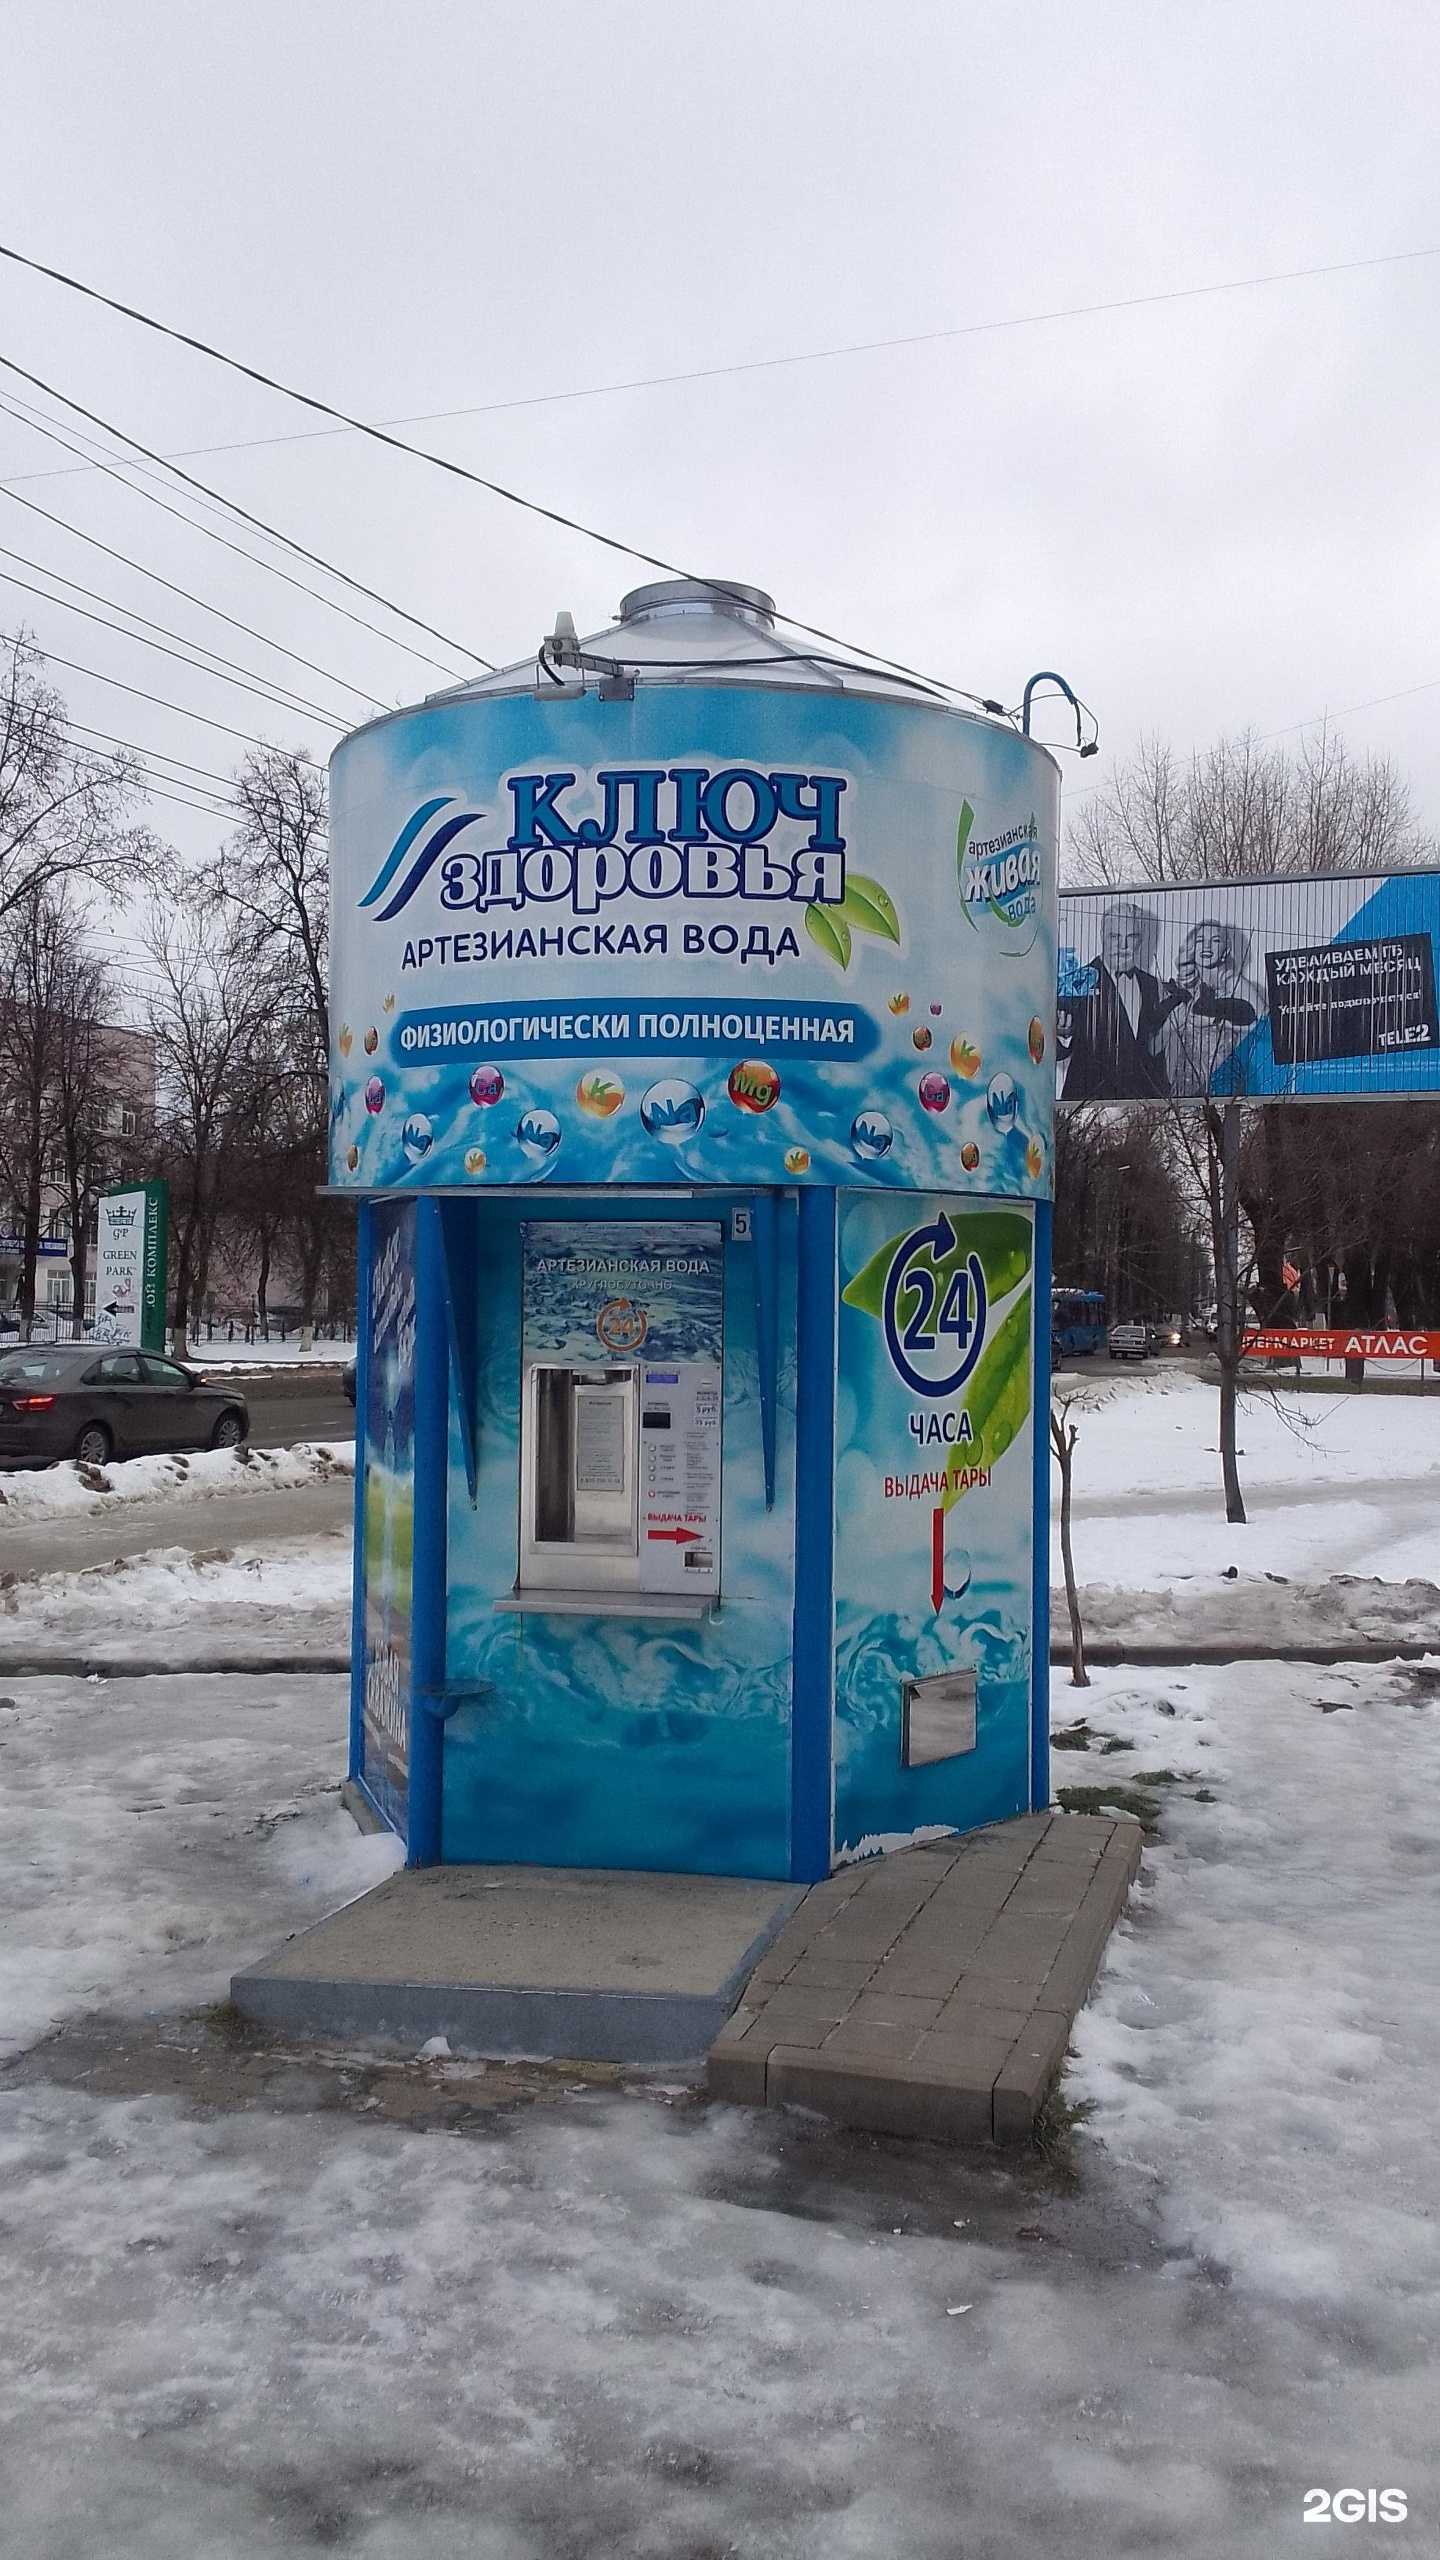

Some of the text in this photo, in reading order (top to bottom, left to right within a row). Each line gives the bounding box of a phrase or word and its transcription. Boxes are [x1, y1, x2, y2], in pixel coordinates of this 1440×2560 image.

[507, 768, 848, 851] КЛЮЧ
[402, 924, 800, 970] АРТЕЗИАНСКАЯ ВОДА
[1275, 946, 1378, 972] УДВАИВАЕМ
[1276, 956, 1421, 986] КАЖДЫЙ МЕСЯЦ
[400, 1015, 630, 1051] ФИЗИОЛОГИЧЕСКИ
[639, 1013, 855, 1044] ПОЛНОЦЕННАЯ
[1378, 1023, 1431, 1047] TELE2
[591, 1077, 615, 1104] K
[733, 1073, 773, 1104] Mg
[650, 1099, 697, 1128] Na
[146, 1197, 159, 1278] КОМПЛЕКС
[735, 1213, 748, 1234] 5
[103, 1250, 137, 1261] GREEN
[537, 1259, 710, 1276] АРТЕЗИАНСКАЯ ВОДА
[106, 1265, 133, 1276] PARK
[903, 1269, 972, 1350] 24
[609, 1318, 635, 1337] 24
[1345, 1335, 1428, 1355] АТЛАС
[910, 1411, 973, 1445] ЧАСА
[884, 1466, 991, 1500] ВЫДАЧА ТАРЫ
[647, 1512, 707, 1523] ВЫДАЧА ТАРЫ
